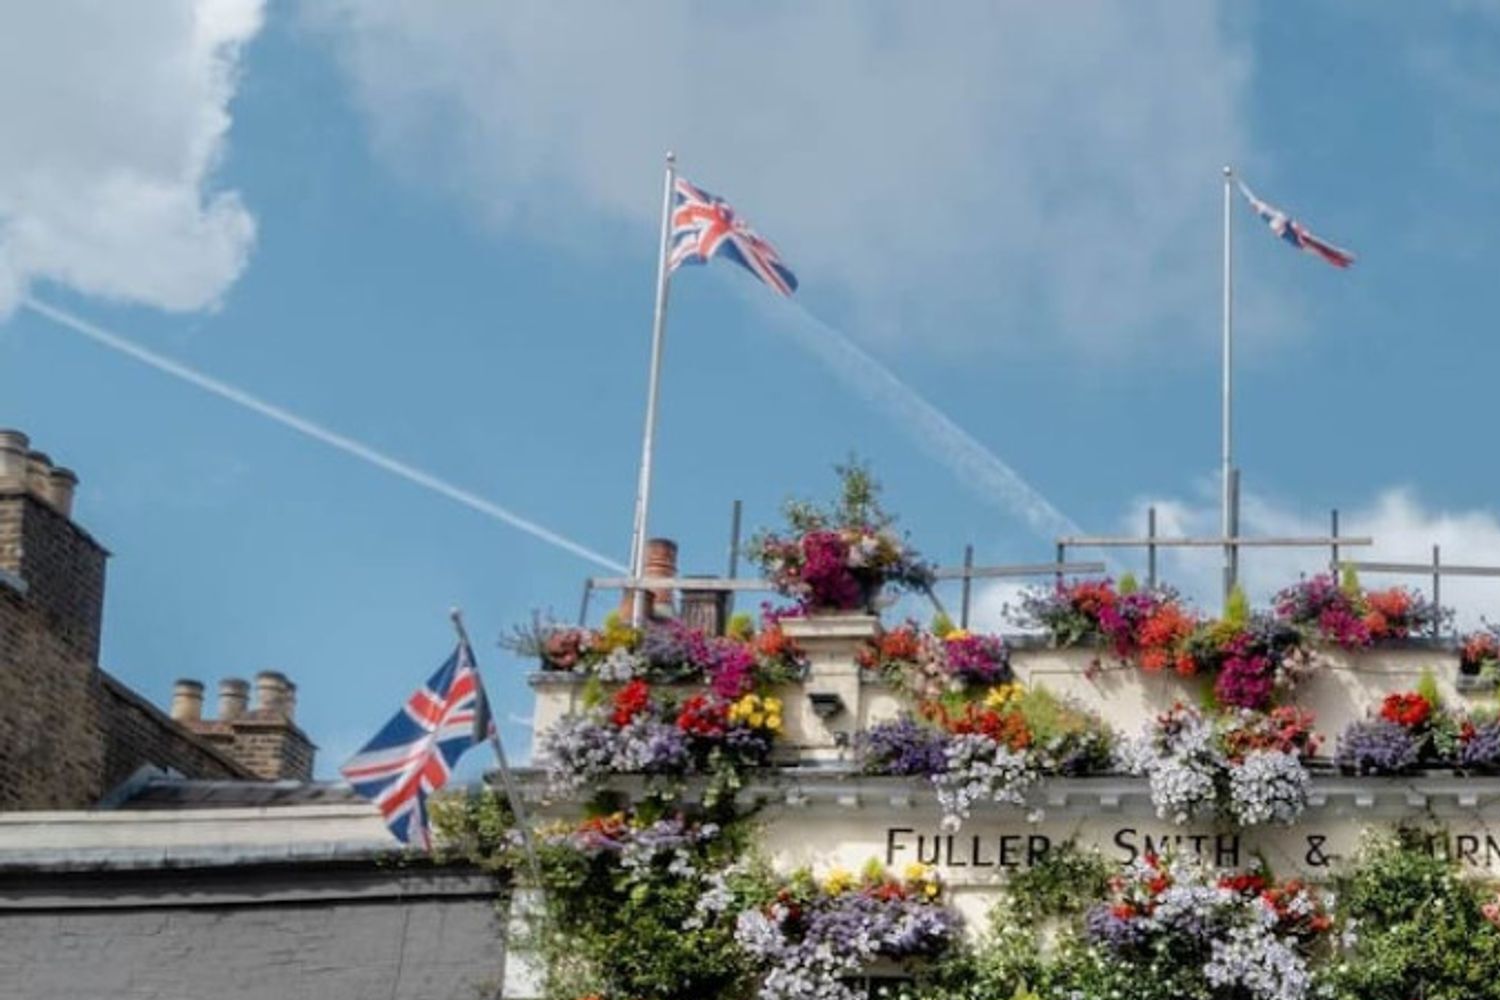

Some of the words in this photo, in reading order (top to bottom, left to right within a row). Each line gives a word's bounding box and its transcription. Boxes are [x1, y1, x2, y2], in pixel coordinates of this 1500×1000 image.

[886, 828, 1051, 867] FULLER
[1113, 828, 1241, 867] SMTH
[1305, 834, 1340, 867] &
